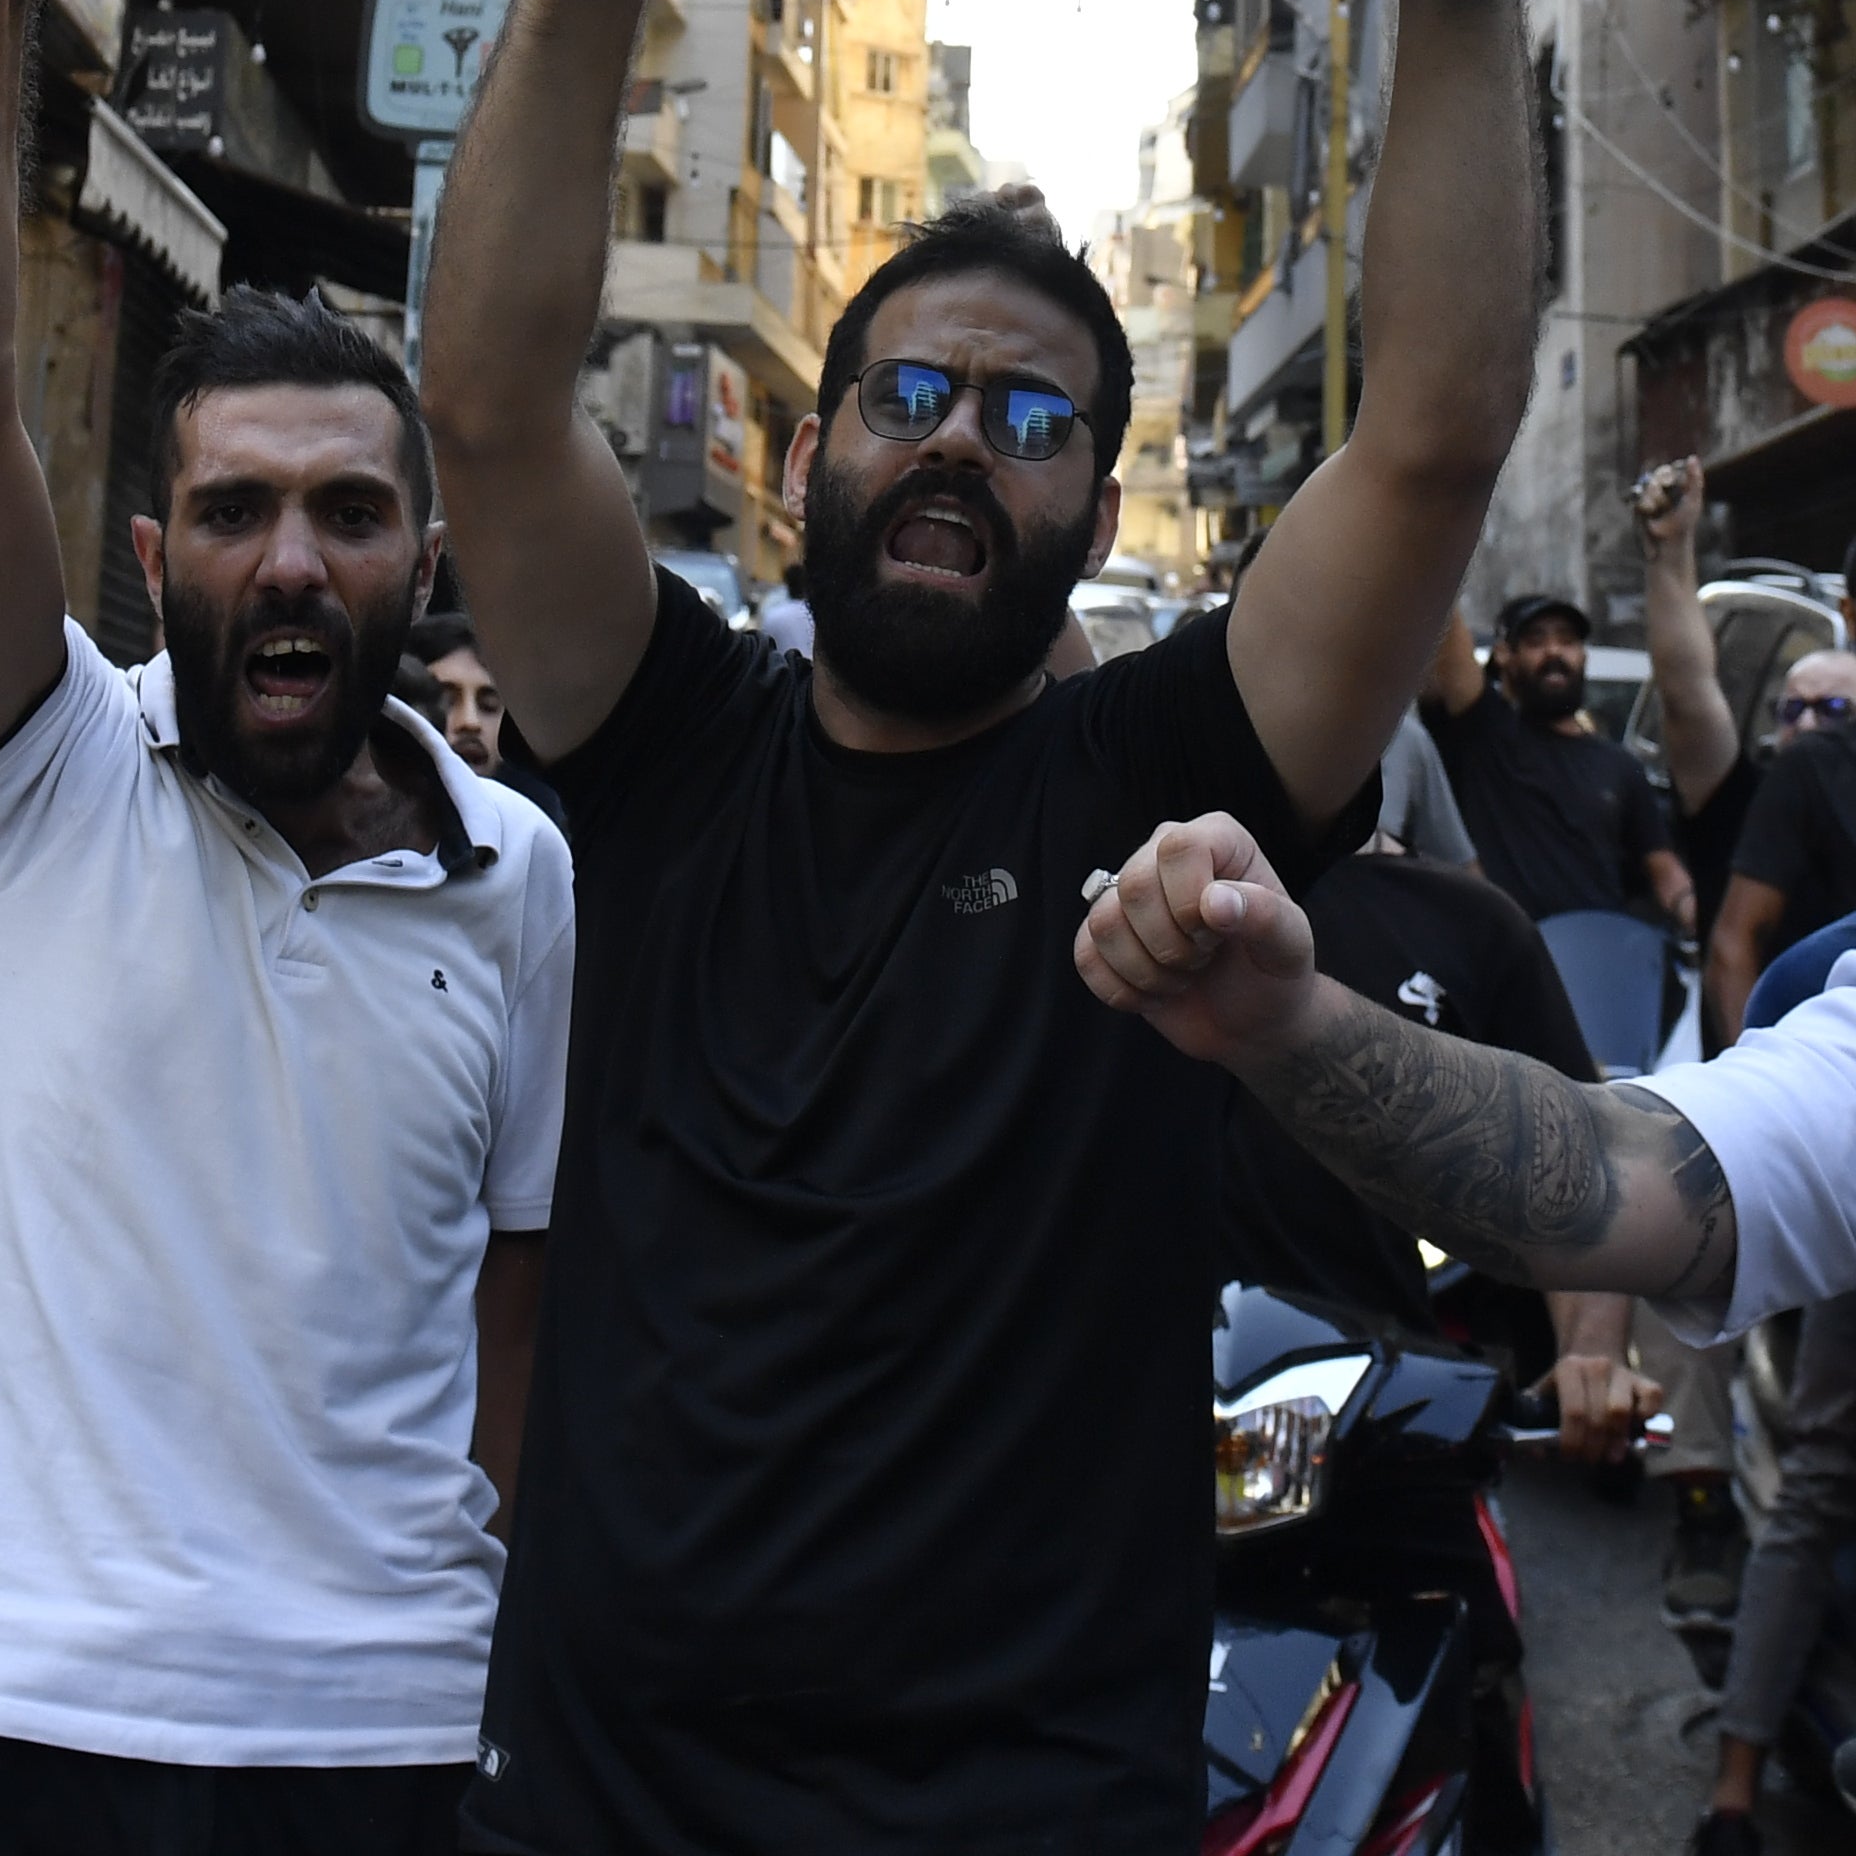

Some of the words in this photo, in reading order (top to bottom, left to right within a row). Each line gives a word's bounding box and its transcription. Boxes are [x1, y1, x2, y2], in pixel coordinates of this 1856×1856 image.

[963, 872, 990, 889] THE
[942, 883, 992, 902] NORTH
[954, 896, 993, 915] FACE
